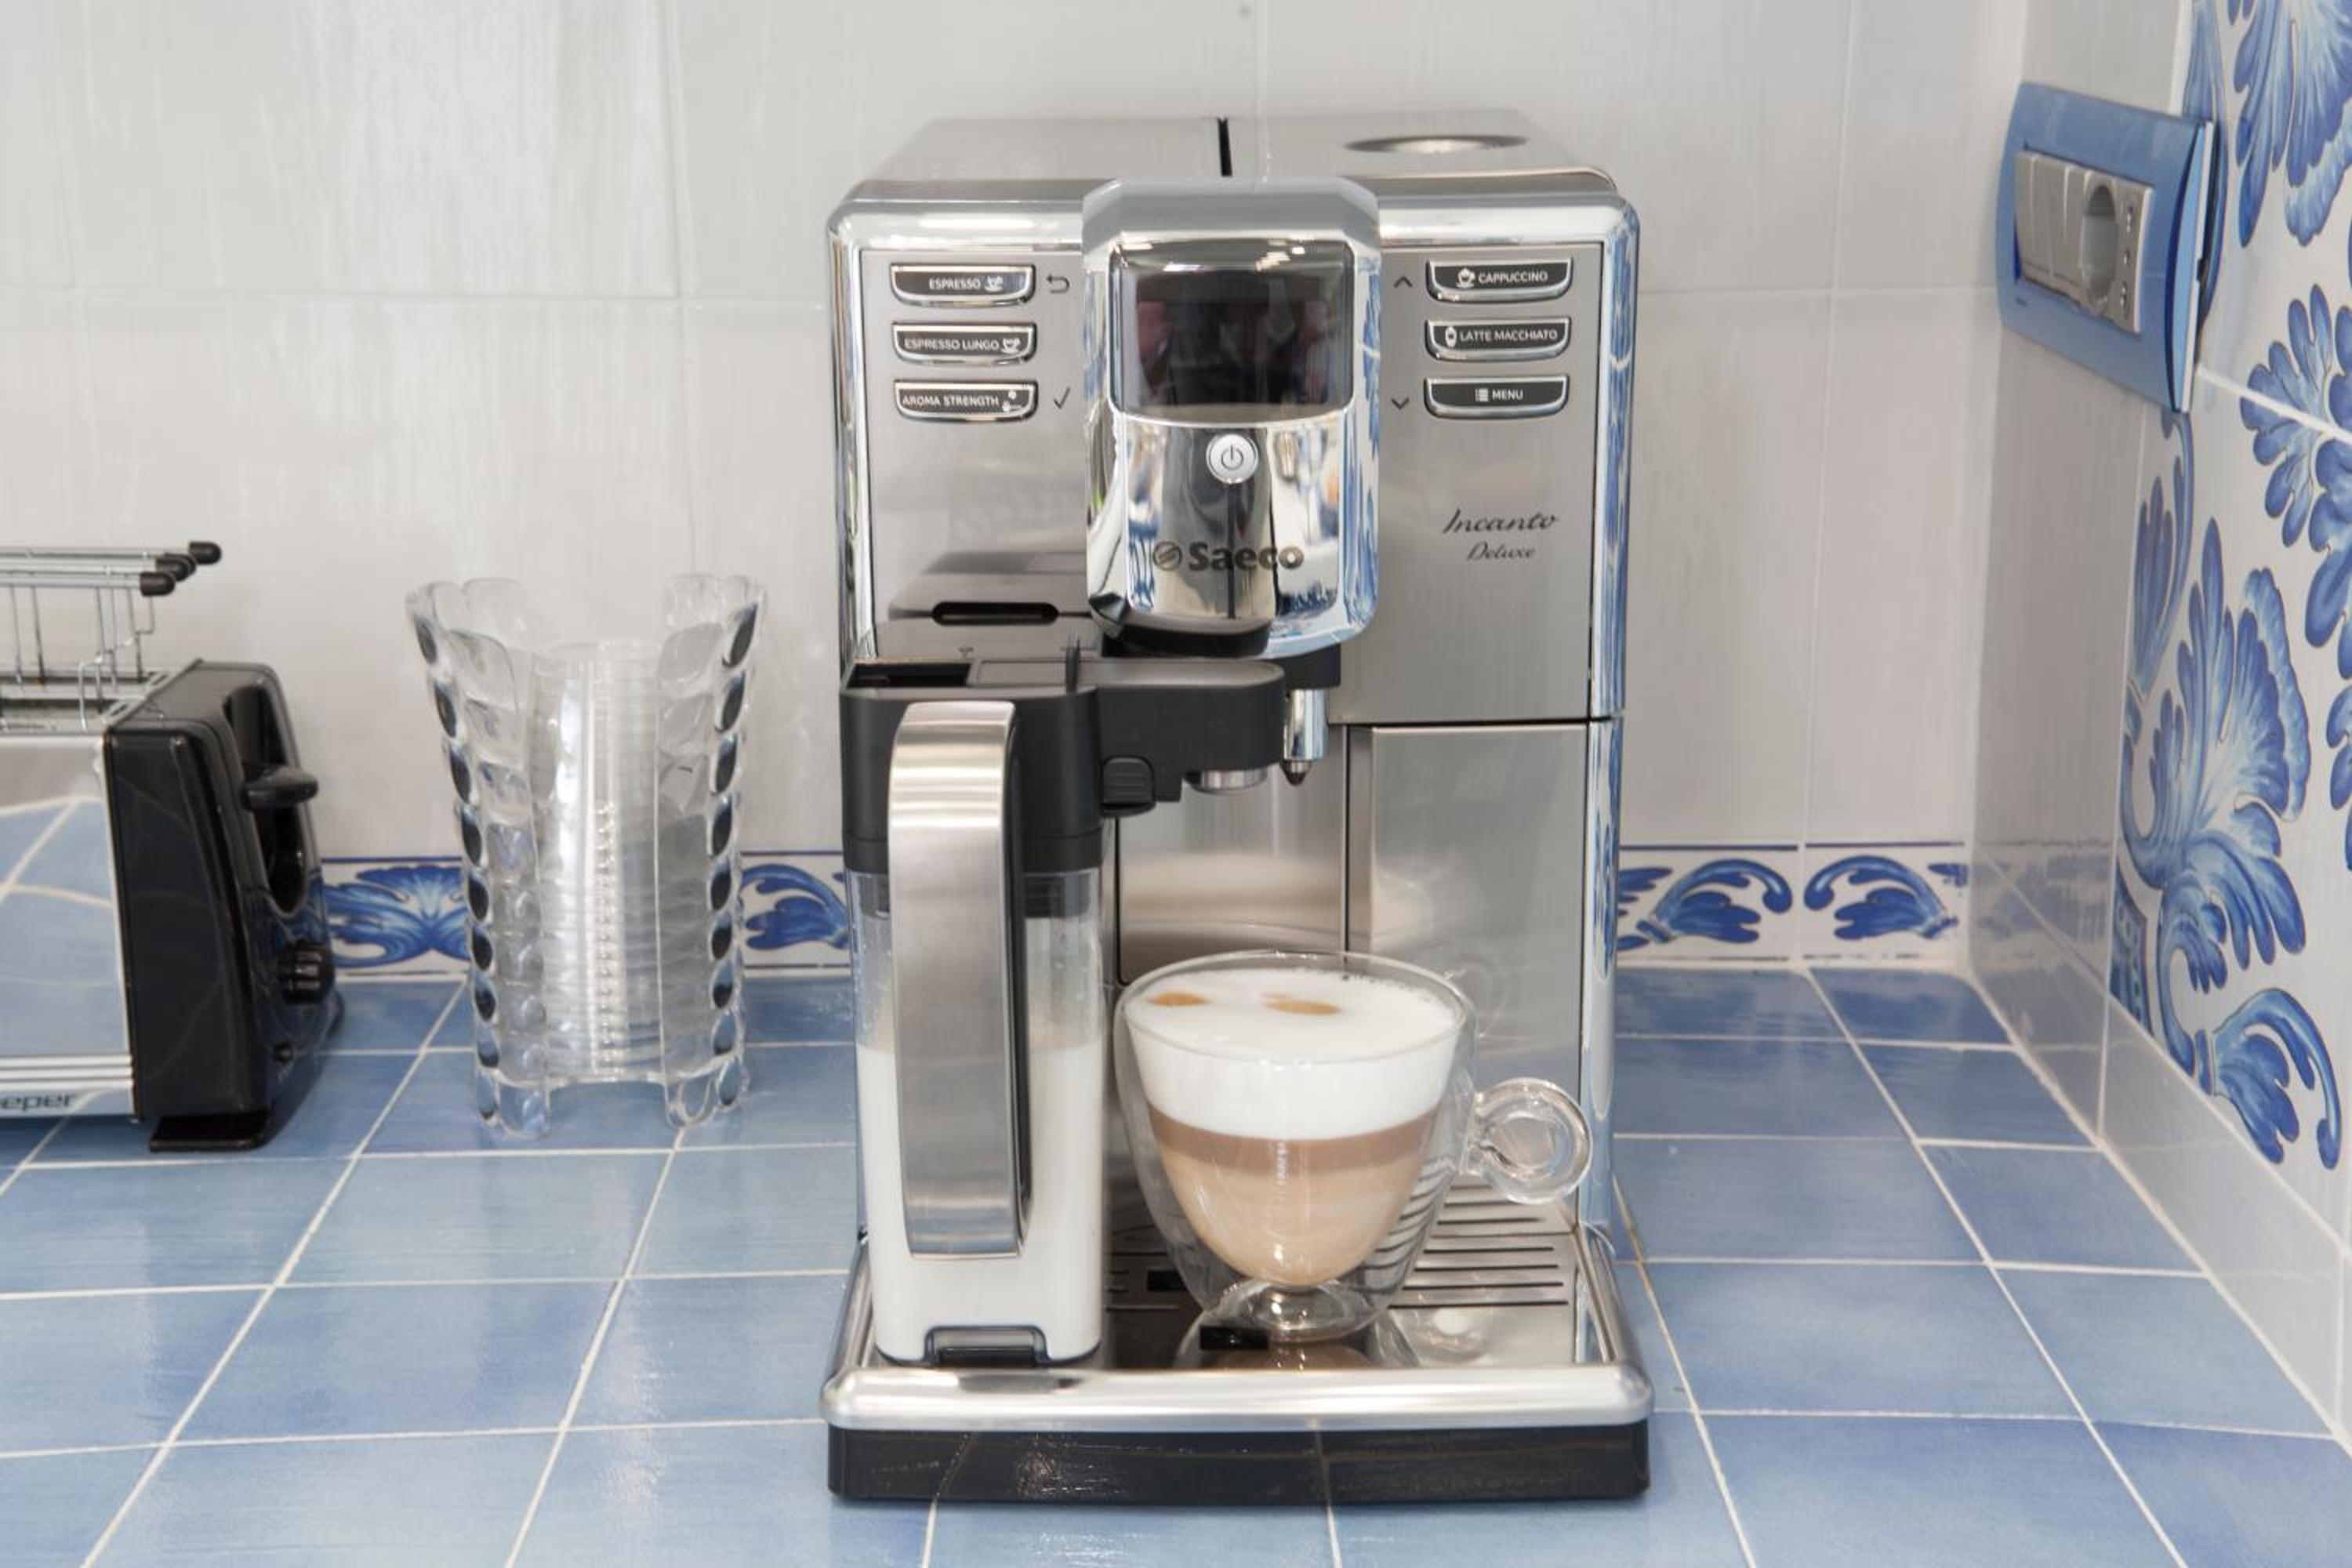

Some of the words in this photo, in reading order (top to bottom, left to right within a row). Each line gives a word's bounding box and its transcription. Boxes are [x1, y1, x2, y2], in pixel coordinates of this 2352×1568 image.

[928, 278, 980, 289] ESPRESSO
[1478, 270, 1548, 285] CAPPUCCINO
[1460, 331, 1491, 342] LATTE
[1494, 329, 1558, 342] MACCHIATO
[905, 339, 960, 350] ESPRESSO
[962, 339, 1000, 350] LUNGO
[902, 395, 941, 406] AROMA
[943, 394, 1000, 407] STRENGTH
[1491, 389, 1523, 401] MENU
[1443, 508, 1559, 534] Incanto
[1189, 542, 1305, 571] Saeco
[1467, 541, 1536, 561] Deluxe
